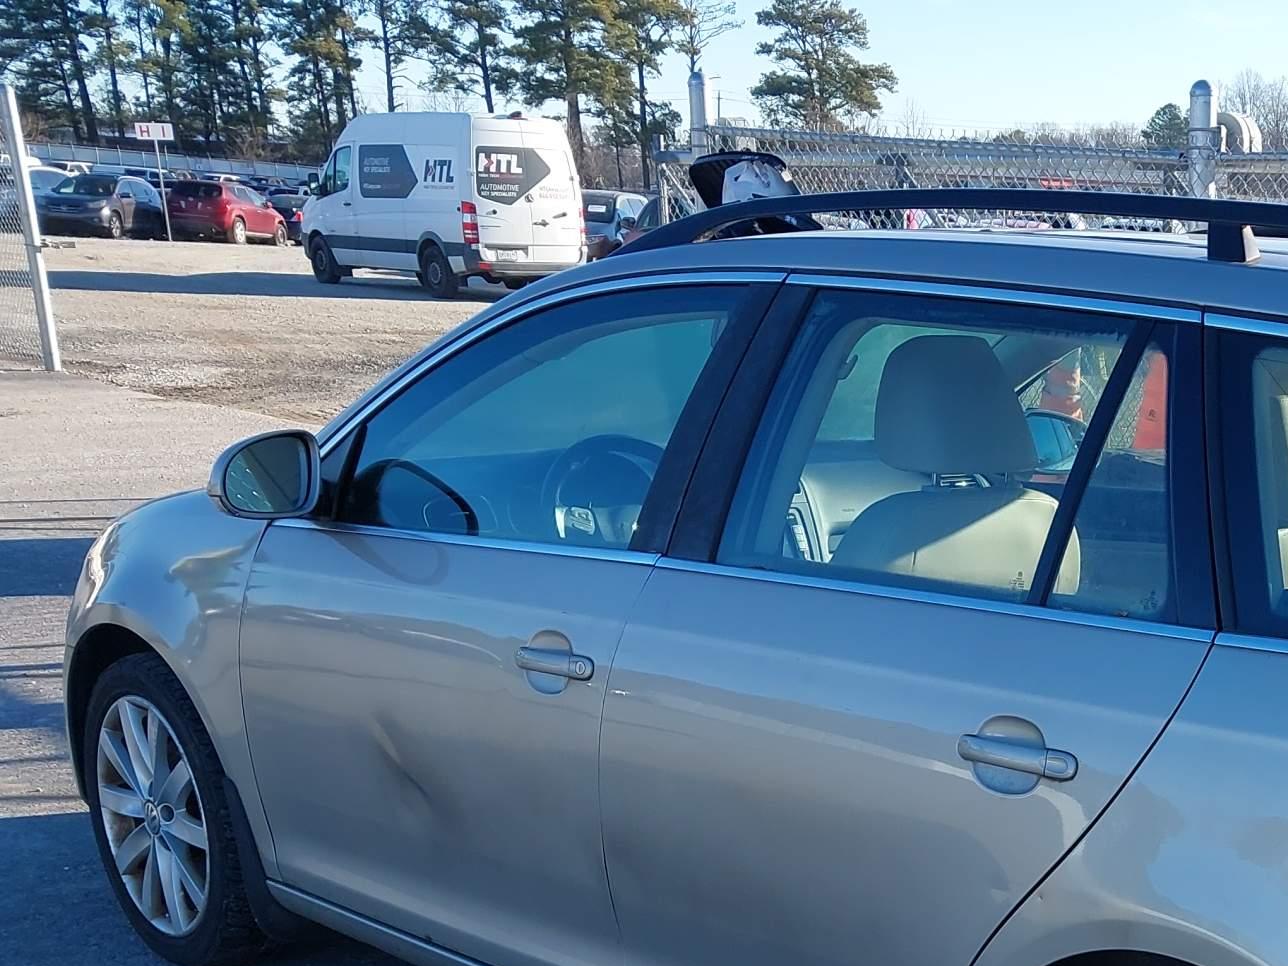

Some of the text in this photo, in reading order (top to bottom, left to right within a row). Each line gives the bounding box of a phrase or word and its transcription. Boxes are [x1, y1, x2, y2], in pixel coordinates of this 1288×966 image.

[139, 125, 151, 137] H
[423, 159, 454, 182] HTL
[478, 153, 523, 173] HTL
[480, 183, 520, 192] AUTOMOTIVE
